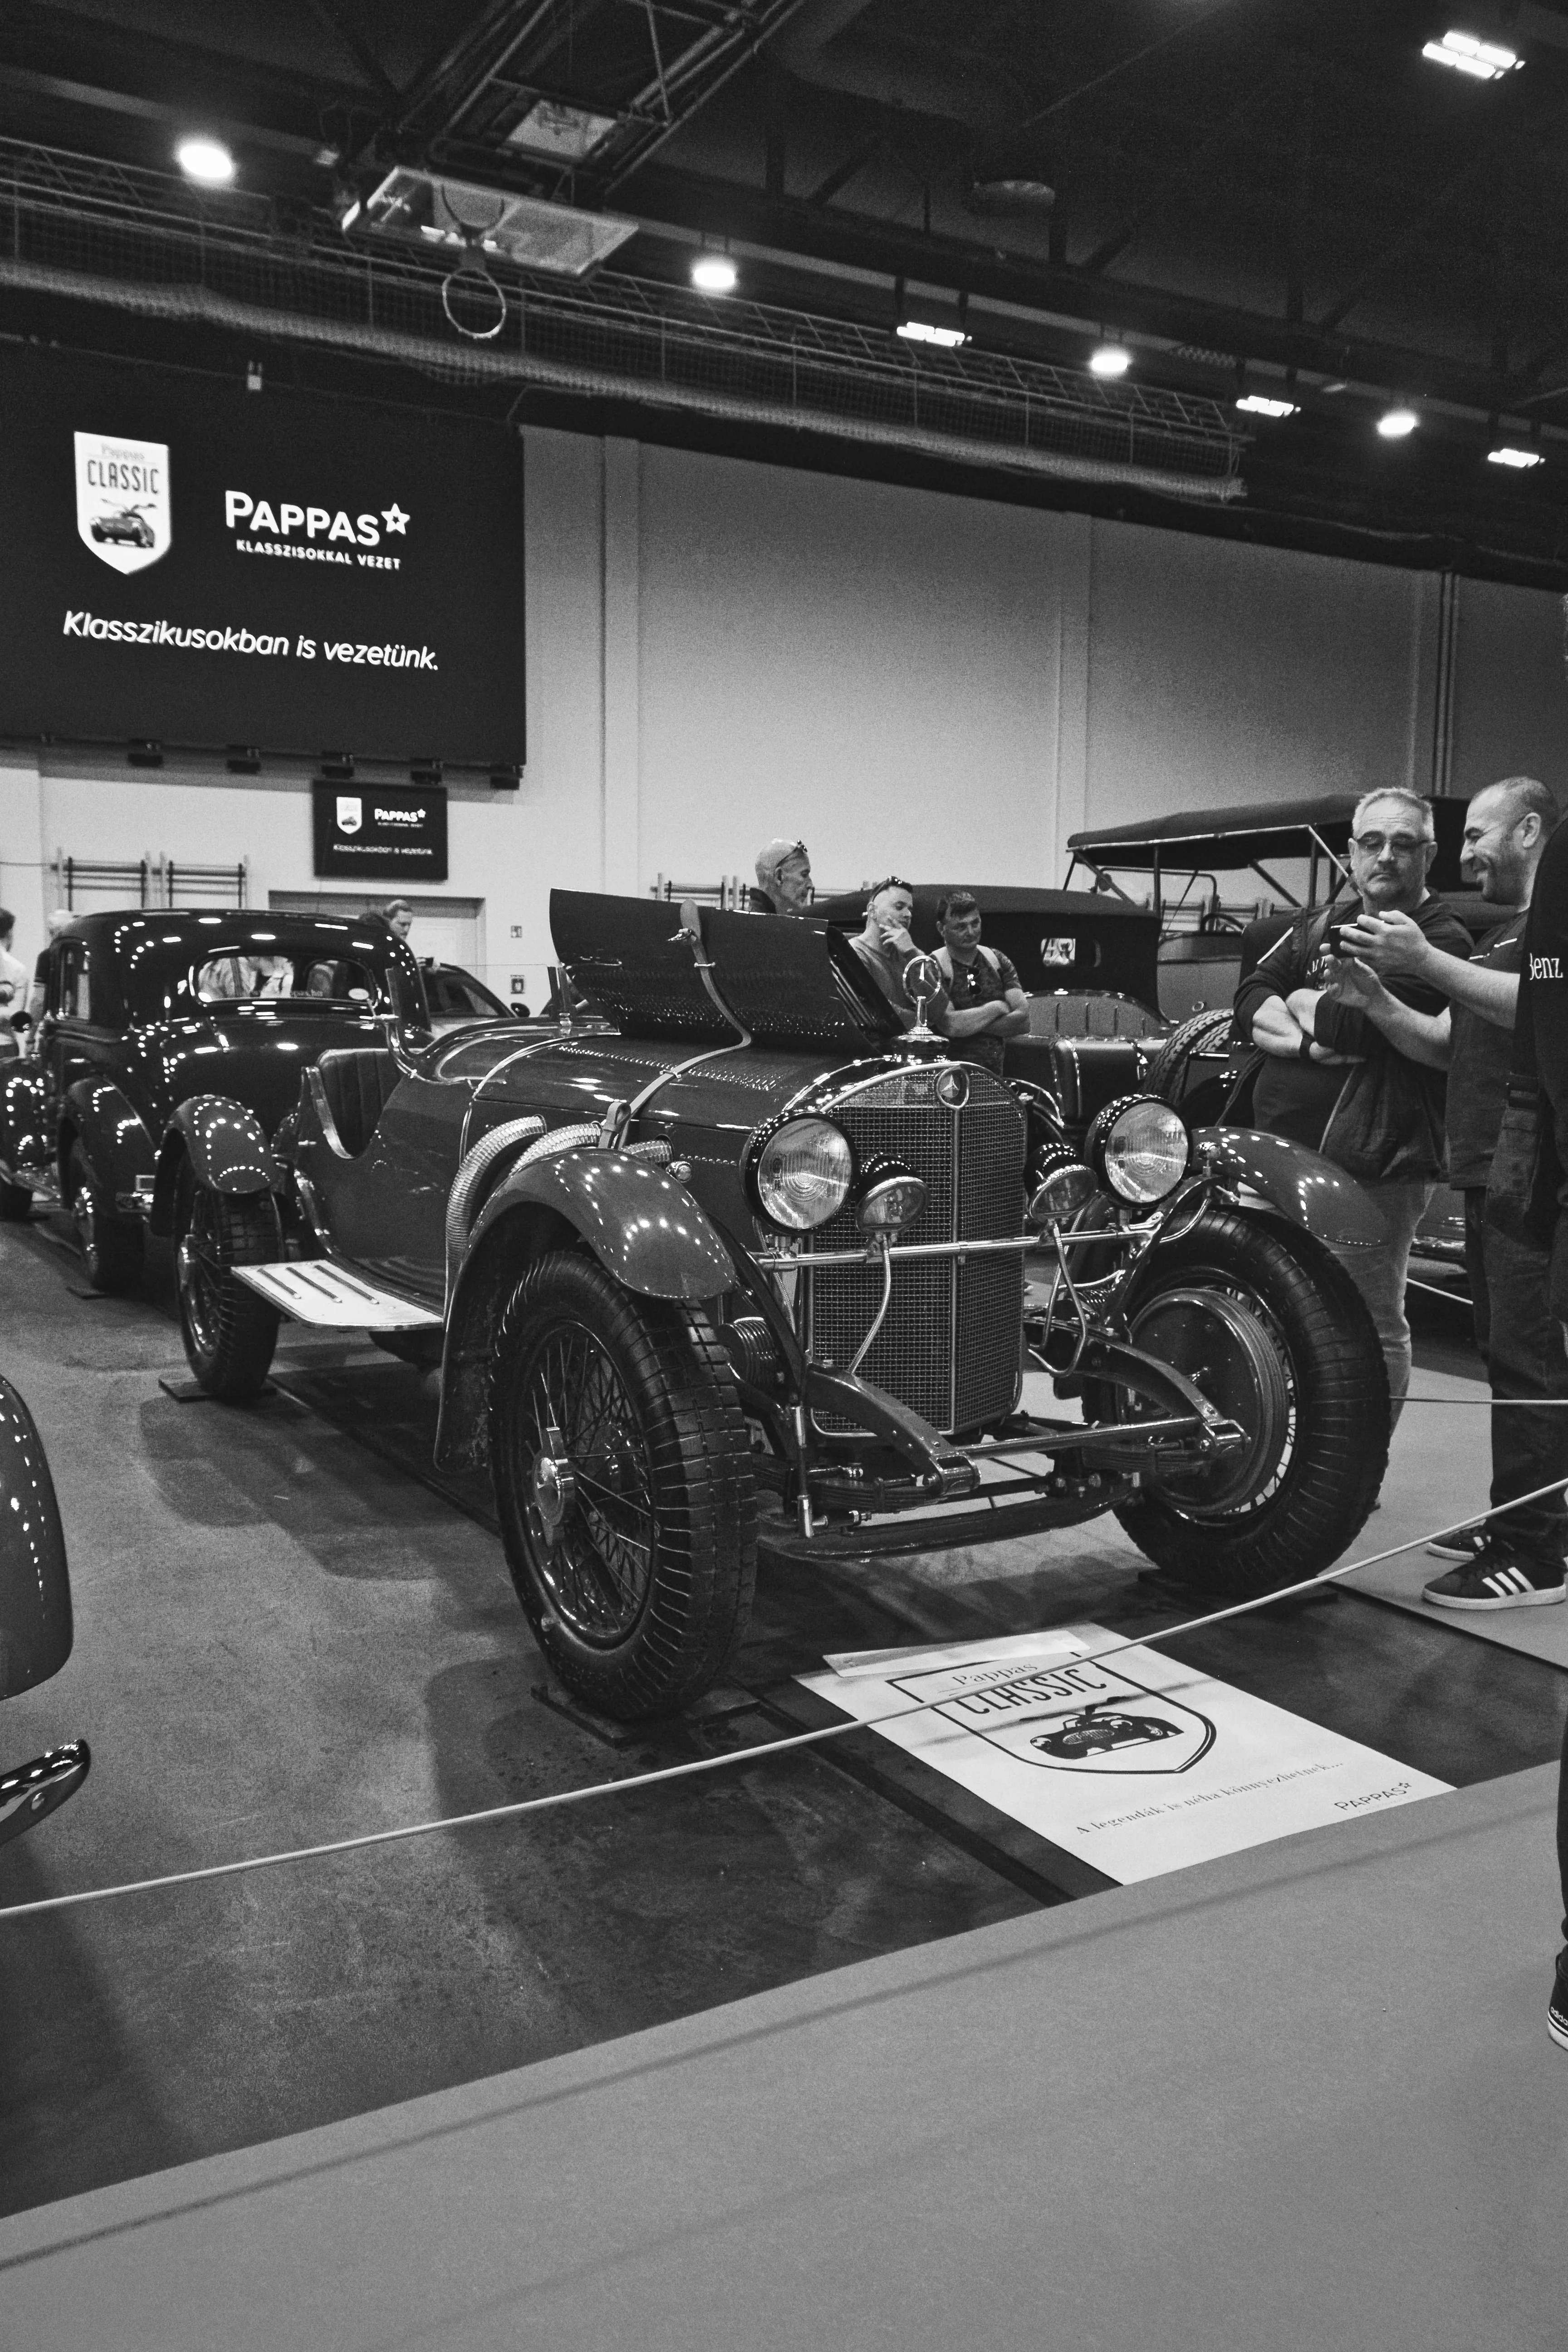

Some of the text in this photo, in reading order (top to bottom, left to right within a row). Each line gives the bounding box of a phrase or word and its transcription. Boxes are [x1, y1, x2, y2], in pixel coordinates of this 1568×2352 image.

[88, 460, 159, 495] CLASSIC
[225, 490, 380, 545] PAPPAS
[236, 539, 401, 570] KLASSZISOKKAL VEZET
[63, 610, 438, 670] Klasszikusokban is vezetünk.
[375, 808, 418, 822] PAPPAS
[952, 1663, 1038, 1686] Pappas
[1334, 1787, 1407, 1811] PAPPAS
[1077, 1826, 1091, 1834] A
